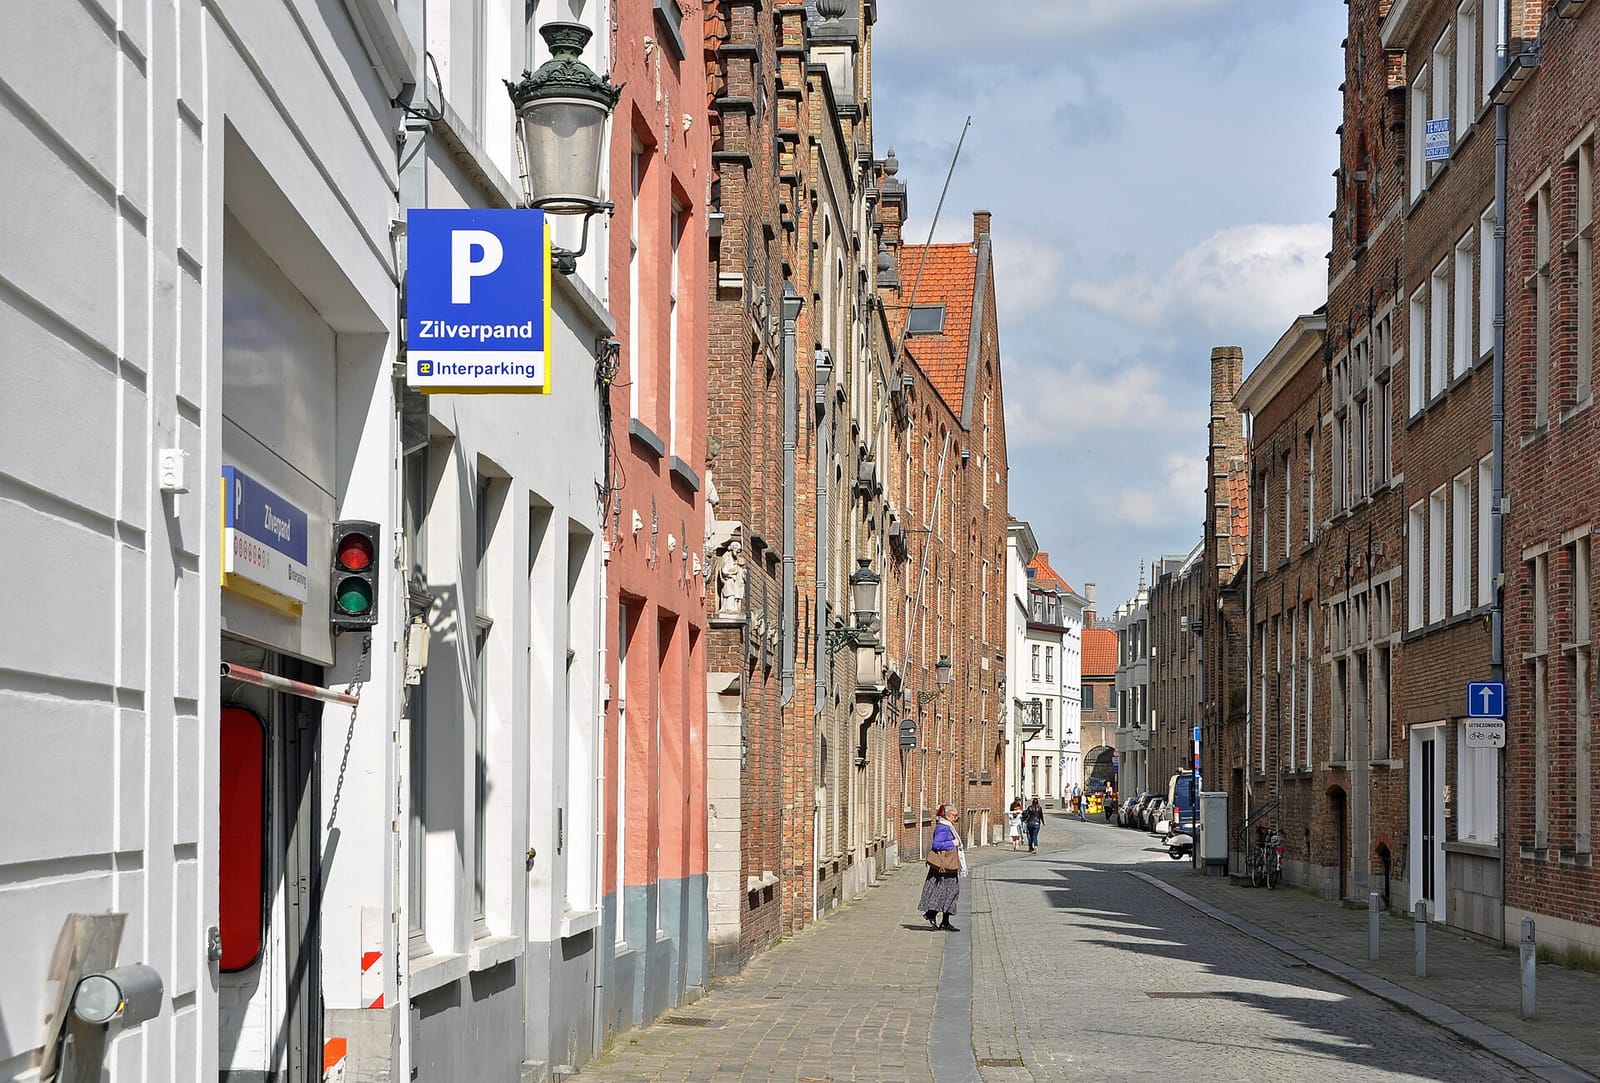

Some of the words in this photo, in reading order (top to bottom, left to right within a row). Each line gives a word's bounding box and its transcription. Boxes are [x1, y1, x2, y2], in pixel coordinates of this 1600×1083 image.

[1427, 122, 1434, 133] TE
[1434, 120, 1448, 132] HUUR
[451, 229, 504, 305] P
[419, 320, 533, 343] Zilverpand
[437, 362, 536, 379] Interparking
[235, 478, 242, 520] P
[264, 504, 291, 541] Zilverpand
